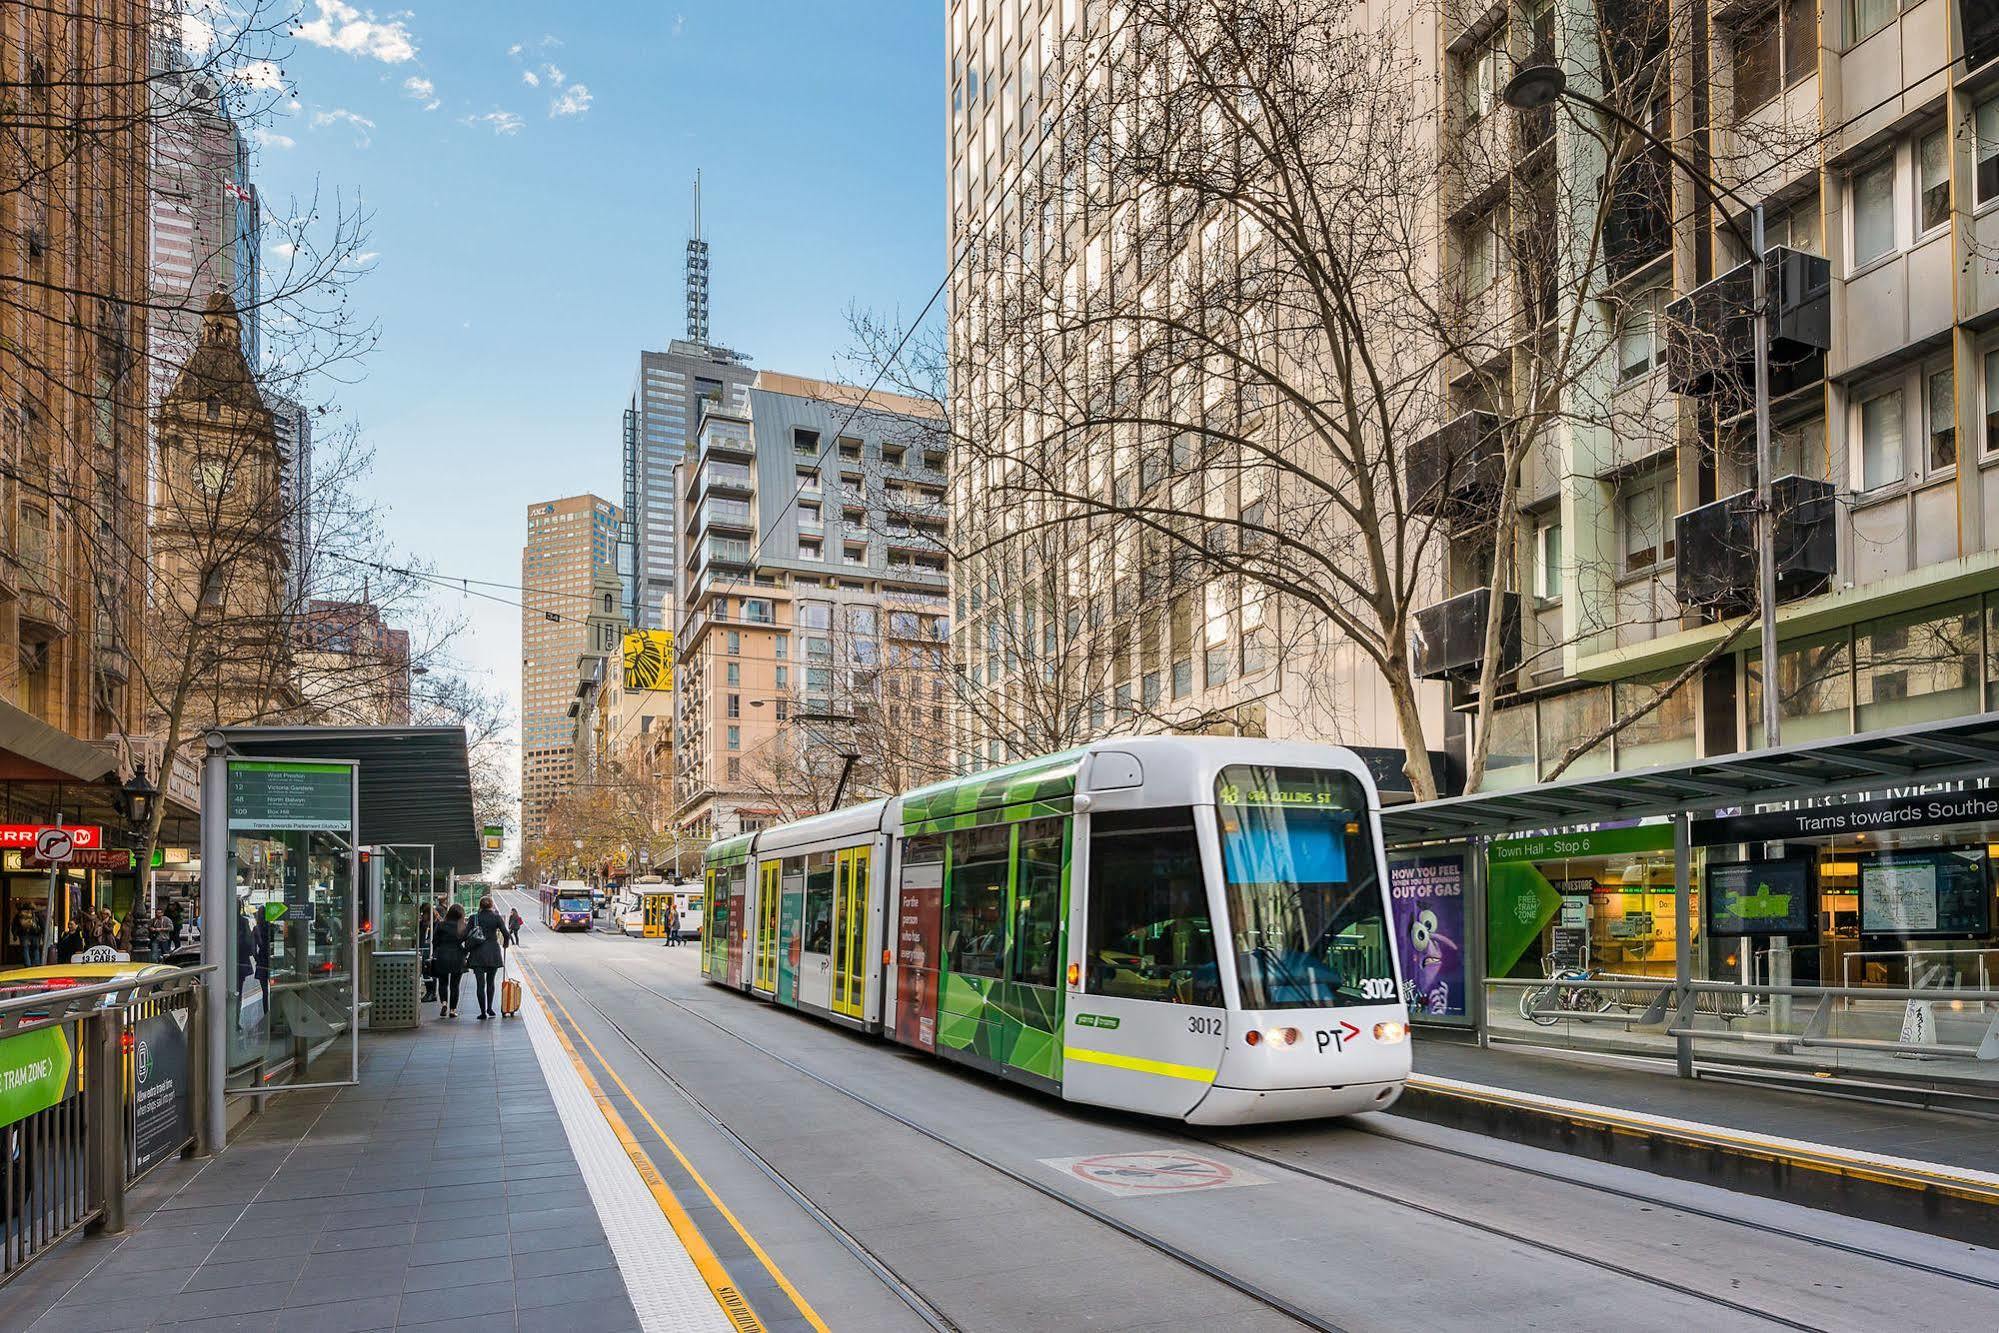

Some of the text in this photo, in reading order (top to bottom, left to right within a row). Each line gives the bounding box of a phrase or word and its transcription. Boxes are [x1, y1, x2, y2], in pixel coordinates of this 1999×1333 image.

[1796, 816, 1846, 832] Trams
[1850, 807, 1922, 826] towards
[1496, 846, 1522, 858] Town
[1525, 843, 1544, 855] Hall
[1553, 840, 1580, 854] Stop
[1582, 839, 1590, 851] 6
[1392, 865, 1460, 880] HOW YOU FEEL
[1392, 879, 1410, 887] WHEN
[1431, 876, 1460, 885] RUNNING
[1393, 884, 1461, 899] OUT OF GAS
[1518, 895, 1537, 904] FREE
[1518, 903, 1537, 911] TRAM
[1518, 910, 1537, 919] ZONE
[82, 955, 117, 963] 13 CABS
[1359, 978, 1396, 1000] 3012
[1188, 1016, 1222, 1036] 3012
[4, 1066, 28, 1091] TRAM
[28, 1058, 47, 1083] ZONE
[716, 1286, 742, 1307] STAND
